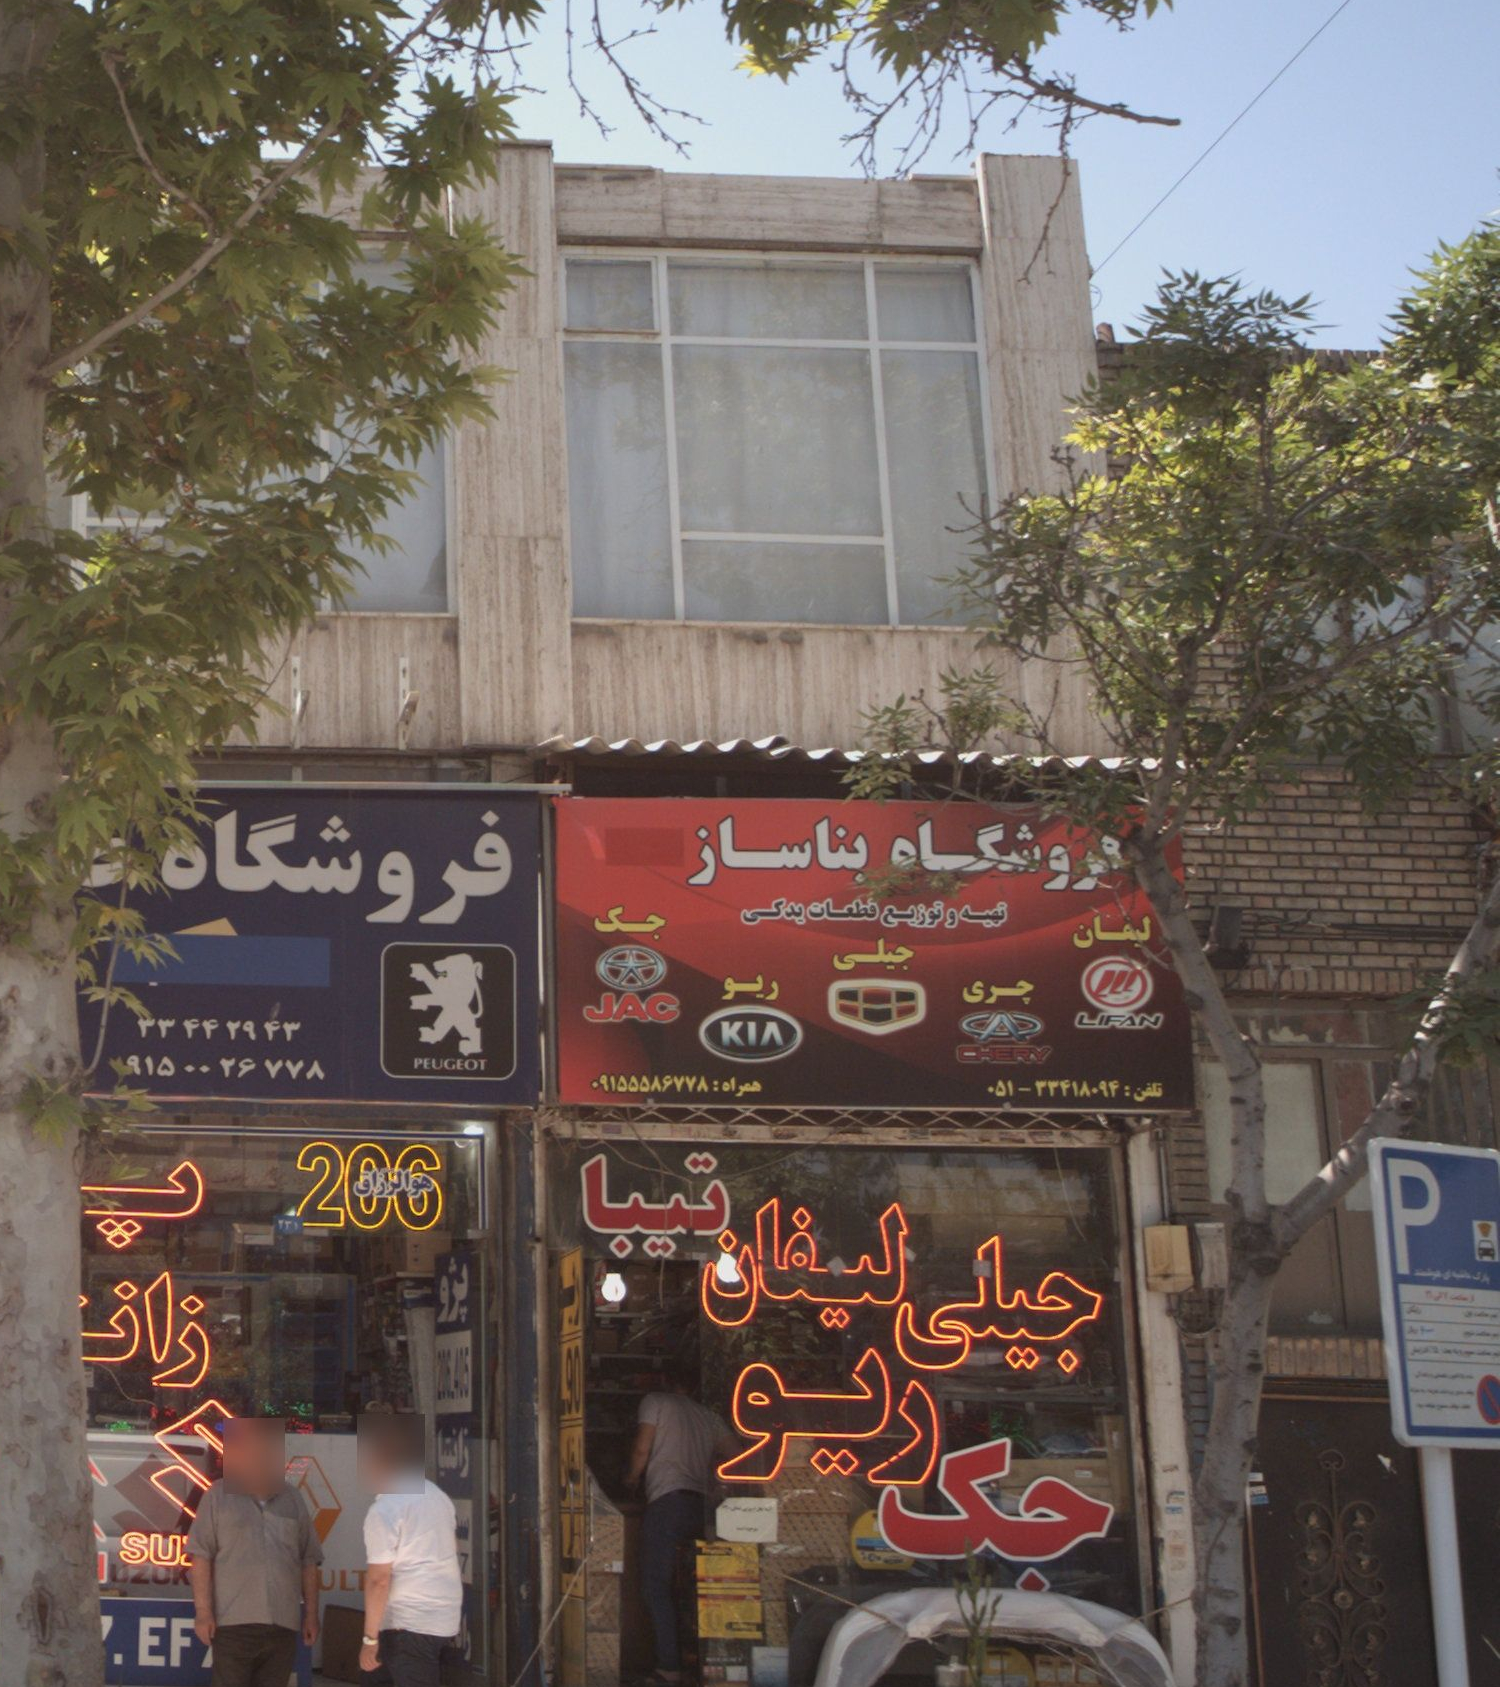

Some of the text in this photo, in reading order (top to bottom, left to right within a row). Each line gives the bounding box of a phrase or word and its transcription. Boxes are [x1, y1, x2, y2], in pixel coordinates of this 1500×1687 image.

[688, 816, 869, 886] بناساز
[594, 906, 668, 940] جک
[741, 898, 1008, 928] تهیه و توزیع قطعات یدکی
[1073, 915, 1152, 949] لیفان
[833, 938, 915, 970] جیلی
[721, 974, 780, 1000] ریو
[962, 980, 1035, 1005] چری
[583, 992, 680, 1024] JAC
[1075, 1012, 1164, 1030] LIFAN
[720, 1020, 785, 1047] KIA
[125, 1054, 176, 1077] ۹۱۵
[413, 1057, 487, 1071] PEUGEOT
[956, 1044, 1053, 1064] CHERY
[296, 1141, 444, 1231] 206
[580, 1152, 731, 1258] تیبا
[702, 1197, 908, 1329] لیفان
[895, 1234, 1102, 1373] جیلی
[717, 1348, 939, 1485] ریو
[878, 1438, 1115, 1592] جک
